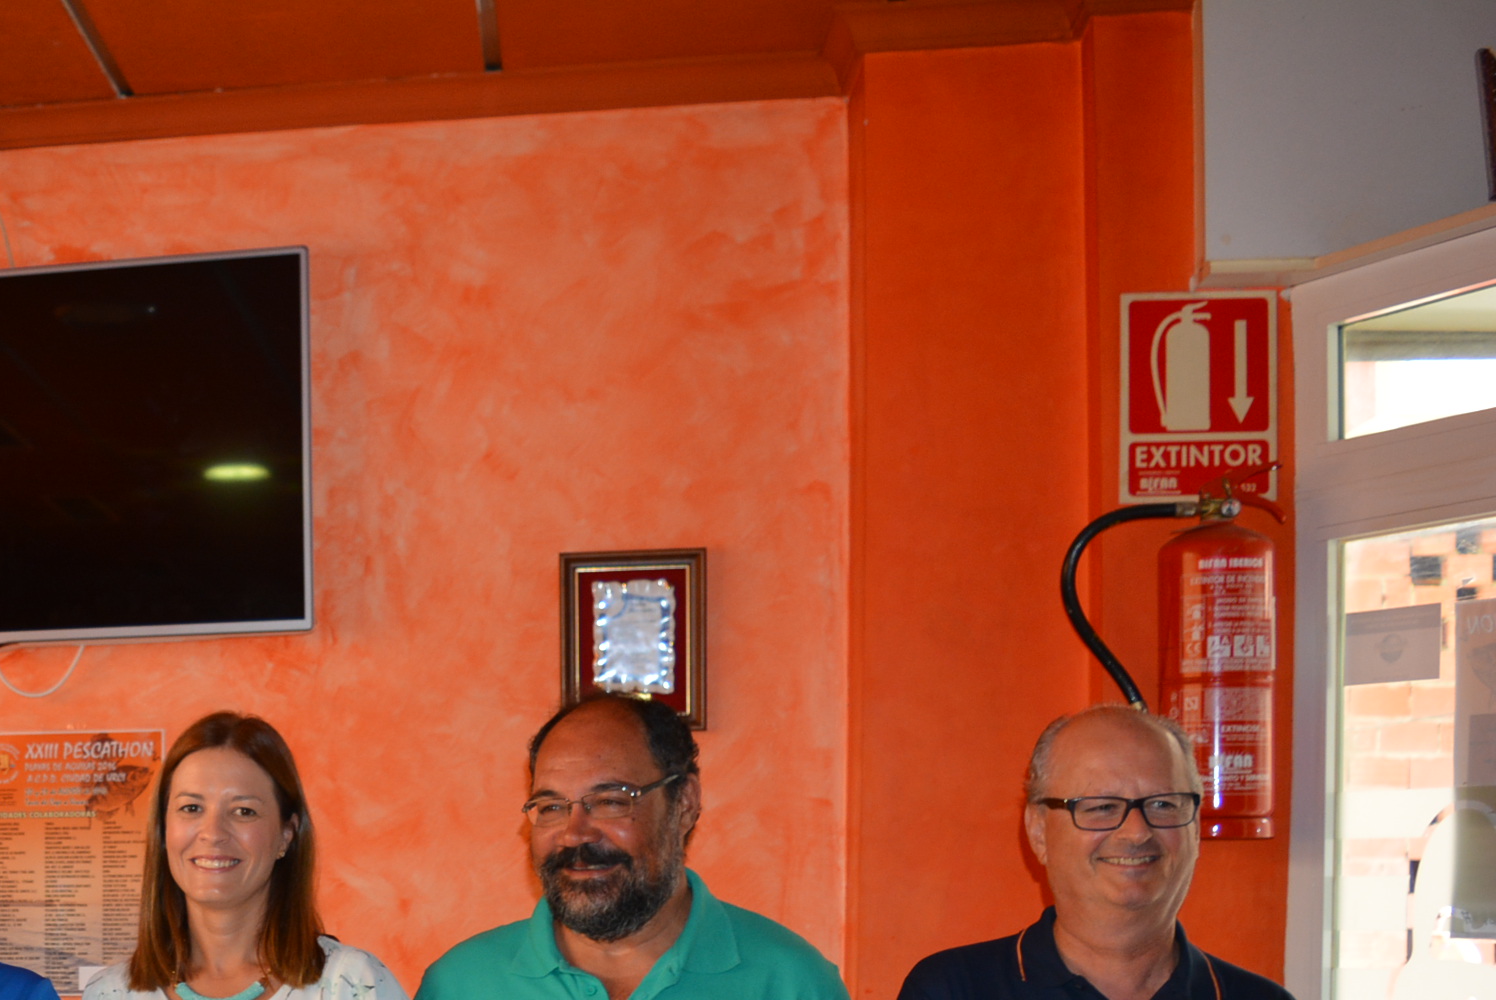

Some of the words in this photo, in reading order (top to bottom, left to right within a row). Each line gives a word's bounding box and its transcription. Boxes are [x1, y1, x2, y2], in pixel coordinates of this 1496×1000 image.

[1135, 444, 1263, 468] EXTINTOR
[24, 743, 59, 760] XXIII
[64, 741, 154, 760] PESCATHON
[93, 773, 104, 782] DE
[29, 810, 96, 819] COLABORADORAS
